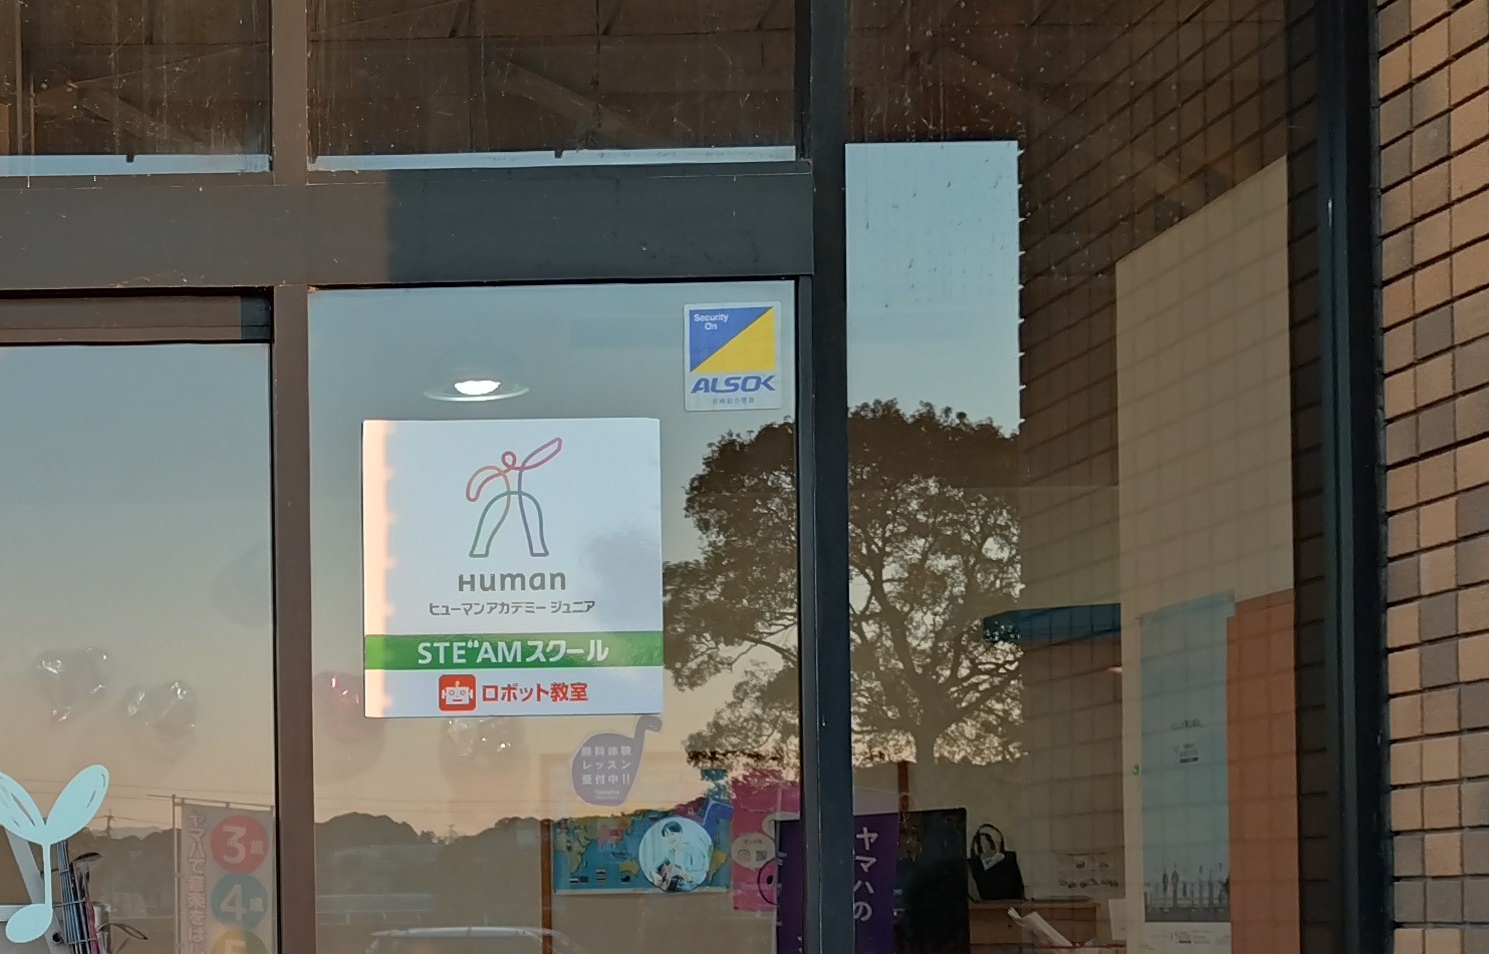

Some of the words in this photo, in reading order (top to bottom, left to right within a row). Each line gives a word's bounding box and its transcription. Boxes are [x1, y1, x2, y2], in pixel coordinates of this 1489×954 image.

[693, 313, 729, 323] Security
[704, 322, 718, 331] On
[691, 375, 776, 394] ALSOK
[458, 571, 566, 593] Human
[429, 601, 547, 616] ヒューマンアカデミー
[550, 600, 595, 614] ジュニア
[482, 683, 588, 703] ロボット教室
[582, 760, 631, 770] レッスン
